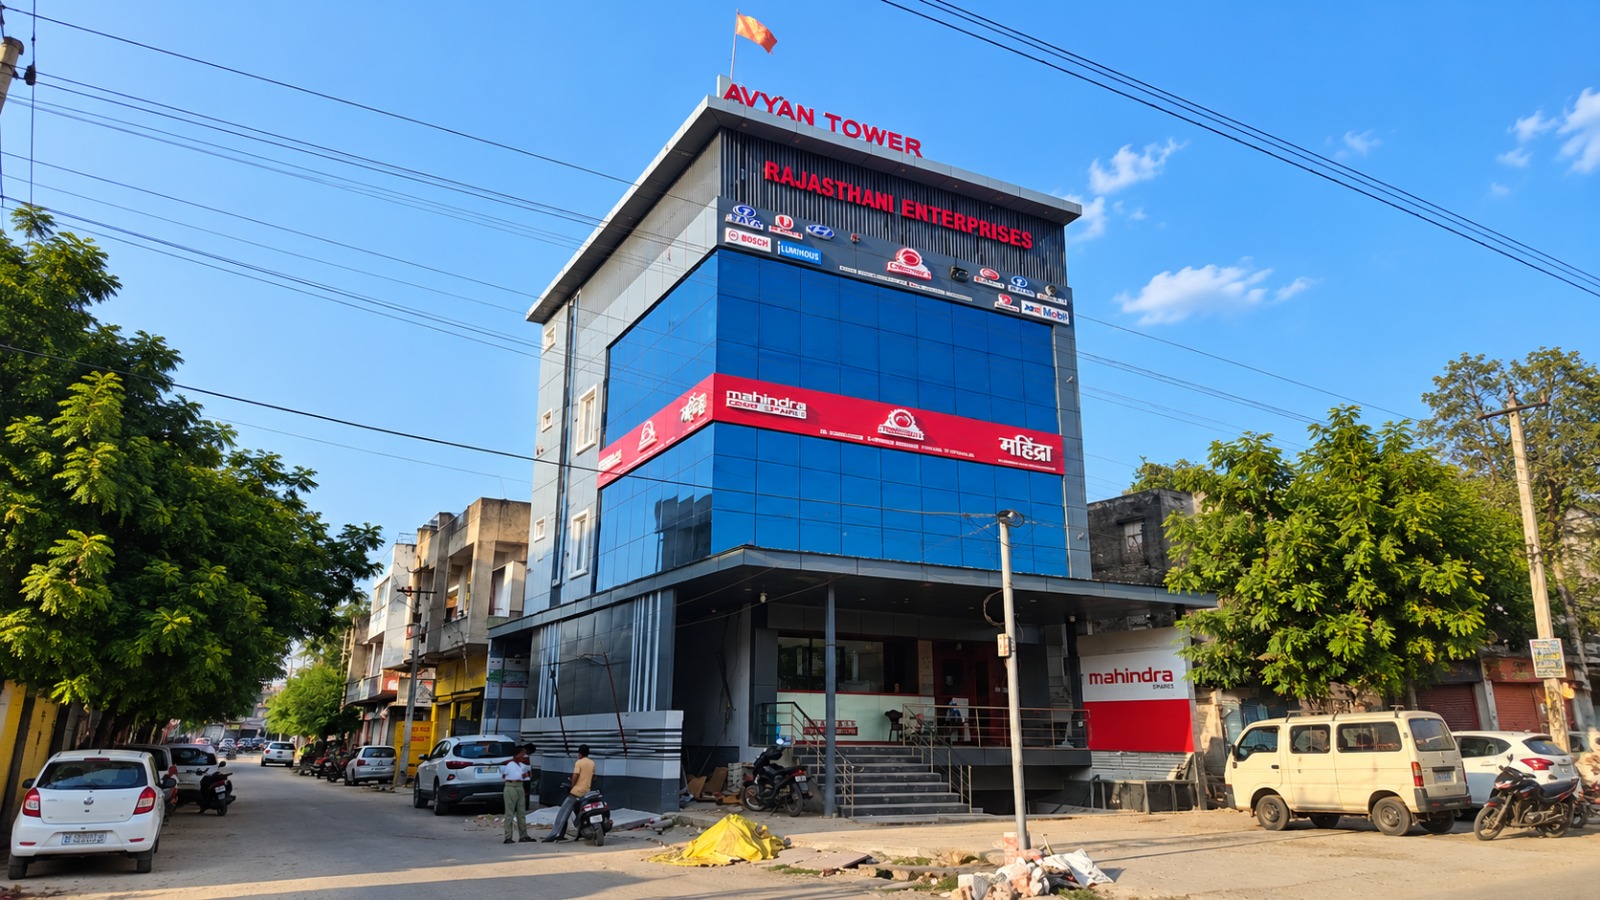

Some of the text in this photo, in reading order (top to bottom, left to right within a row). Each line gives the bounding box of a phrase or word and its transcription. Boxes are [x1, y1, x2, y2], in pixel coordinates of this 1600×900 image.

[724, 84, 922, 157] AVYAN TOWER
[765, 160, 1033, 250] RAJASTHANI ENTERPRISES
[741, 234, 769, 247] BOSCH
[726, 390, 807, 411] mahindra
[998, 434, 1054, 463] महिंद्रा
[1089, 667, 1174, 685] mahindra
